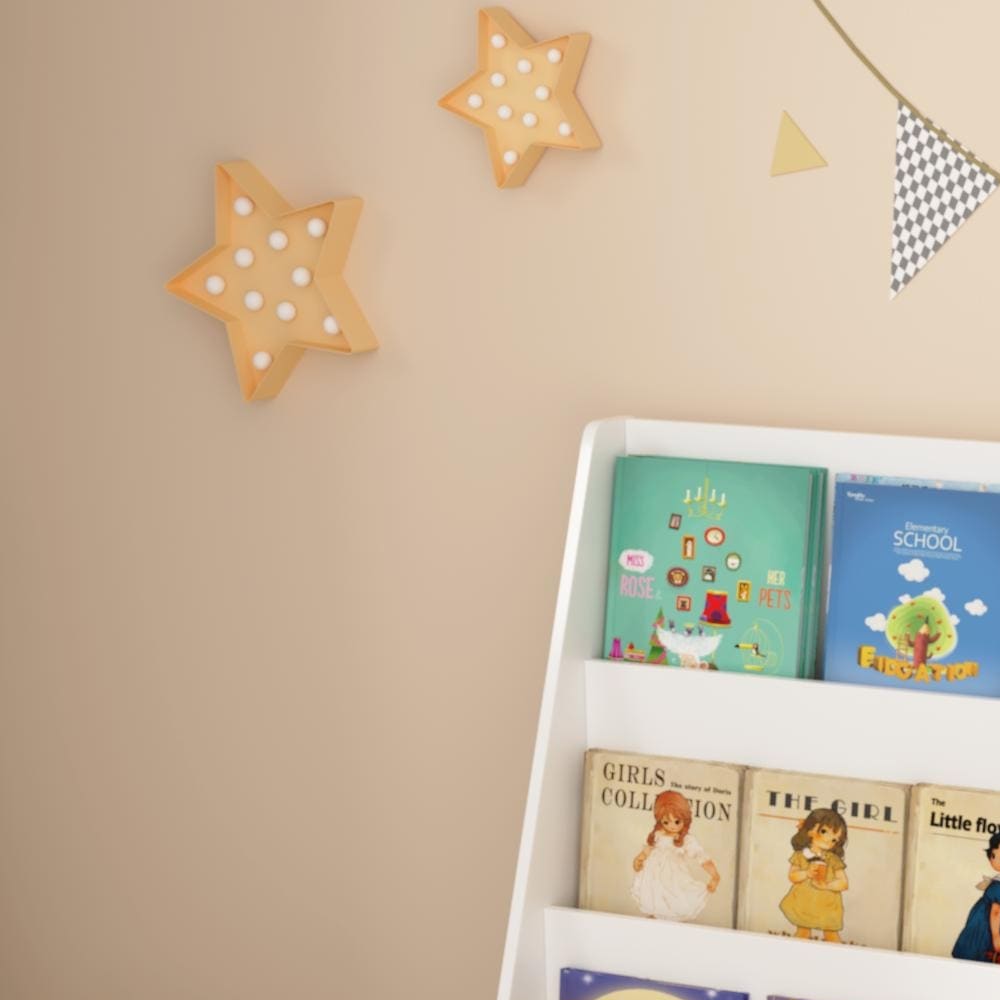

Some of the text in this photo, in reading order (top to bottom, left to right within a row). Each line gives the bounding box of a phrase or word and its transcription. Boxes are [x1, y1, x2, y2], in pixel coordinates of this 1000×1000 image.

[893, 530, 962, 553] SCHOOL
[620, 575, 655, 599] ROSE
[767, 570, 785, 586] HER
[758, 587, 792, 610] PETS
[603, 762, 665, 787] GIRLS
[601, 787, 732, 822] COLLION
[766, 790, 898, 823] THE GIRL
[931, 798, 946, 807] The
[930, 811, 972, 832] Little
